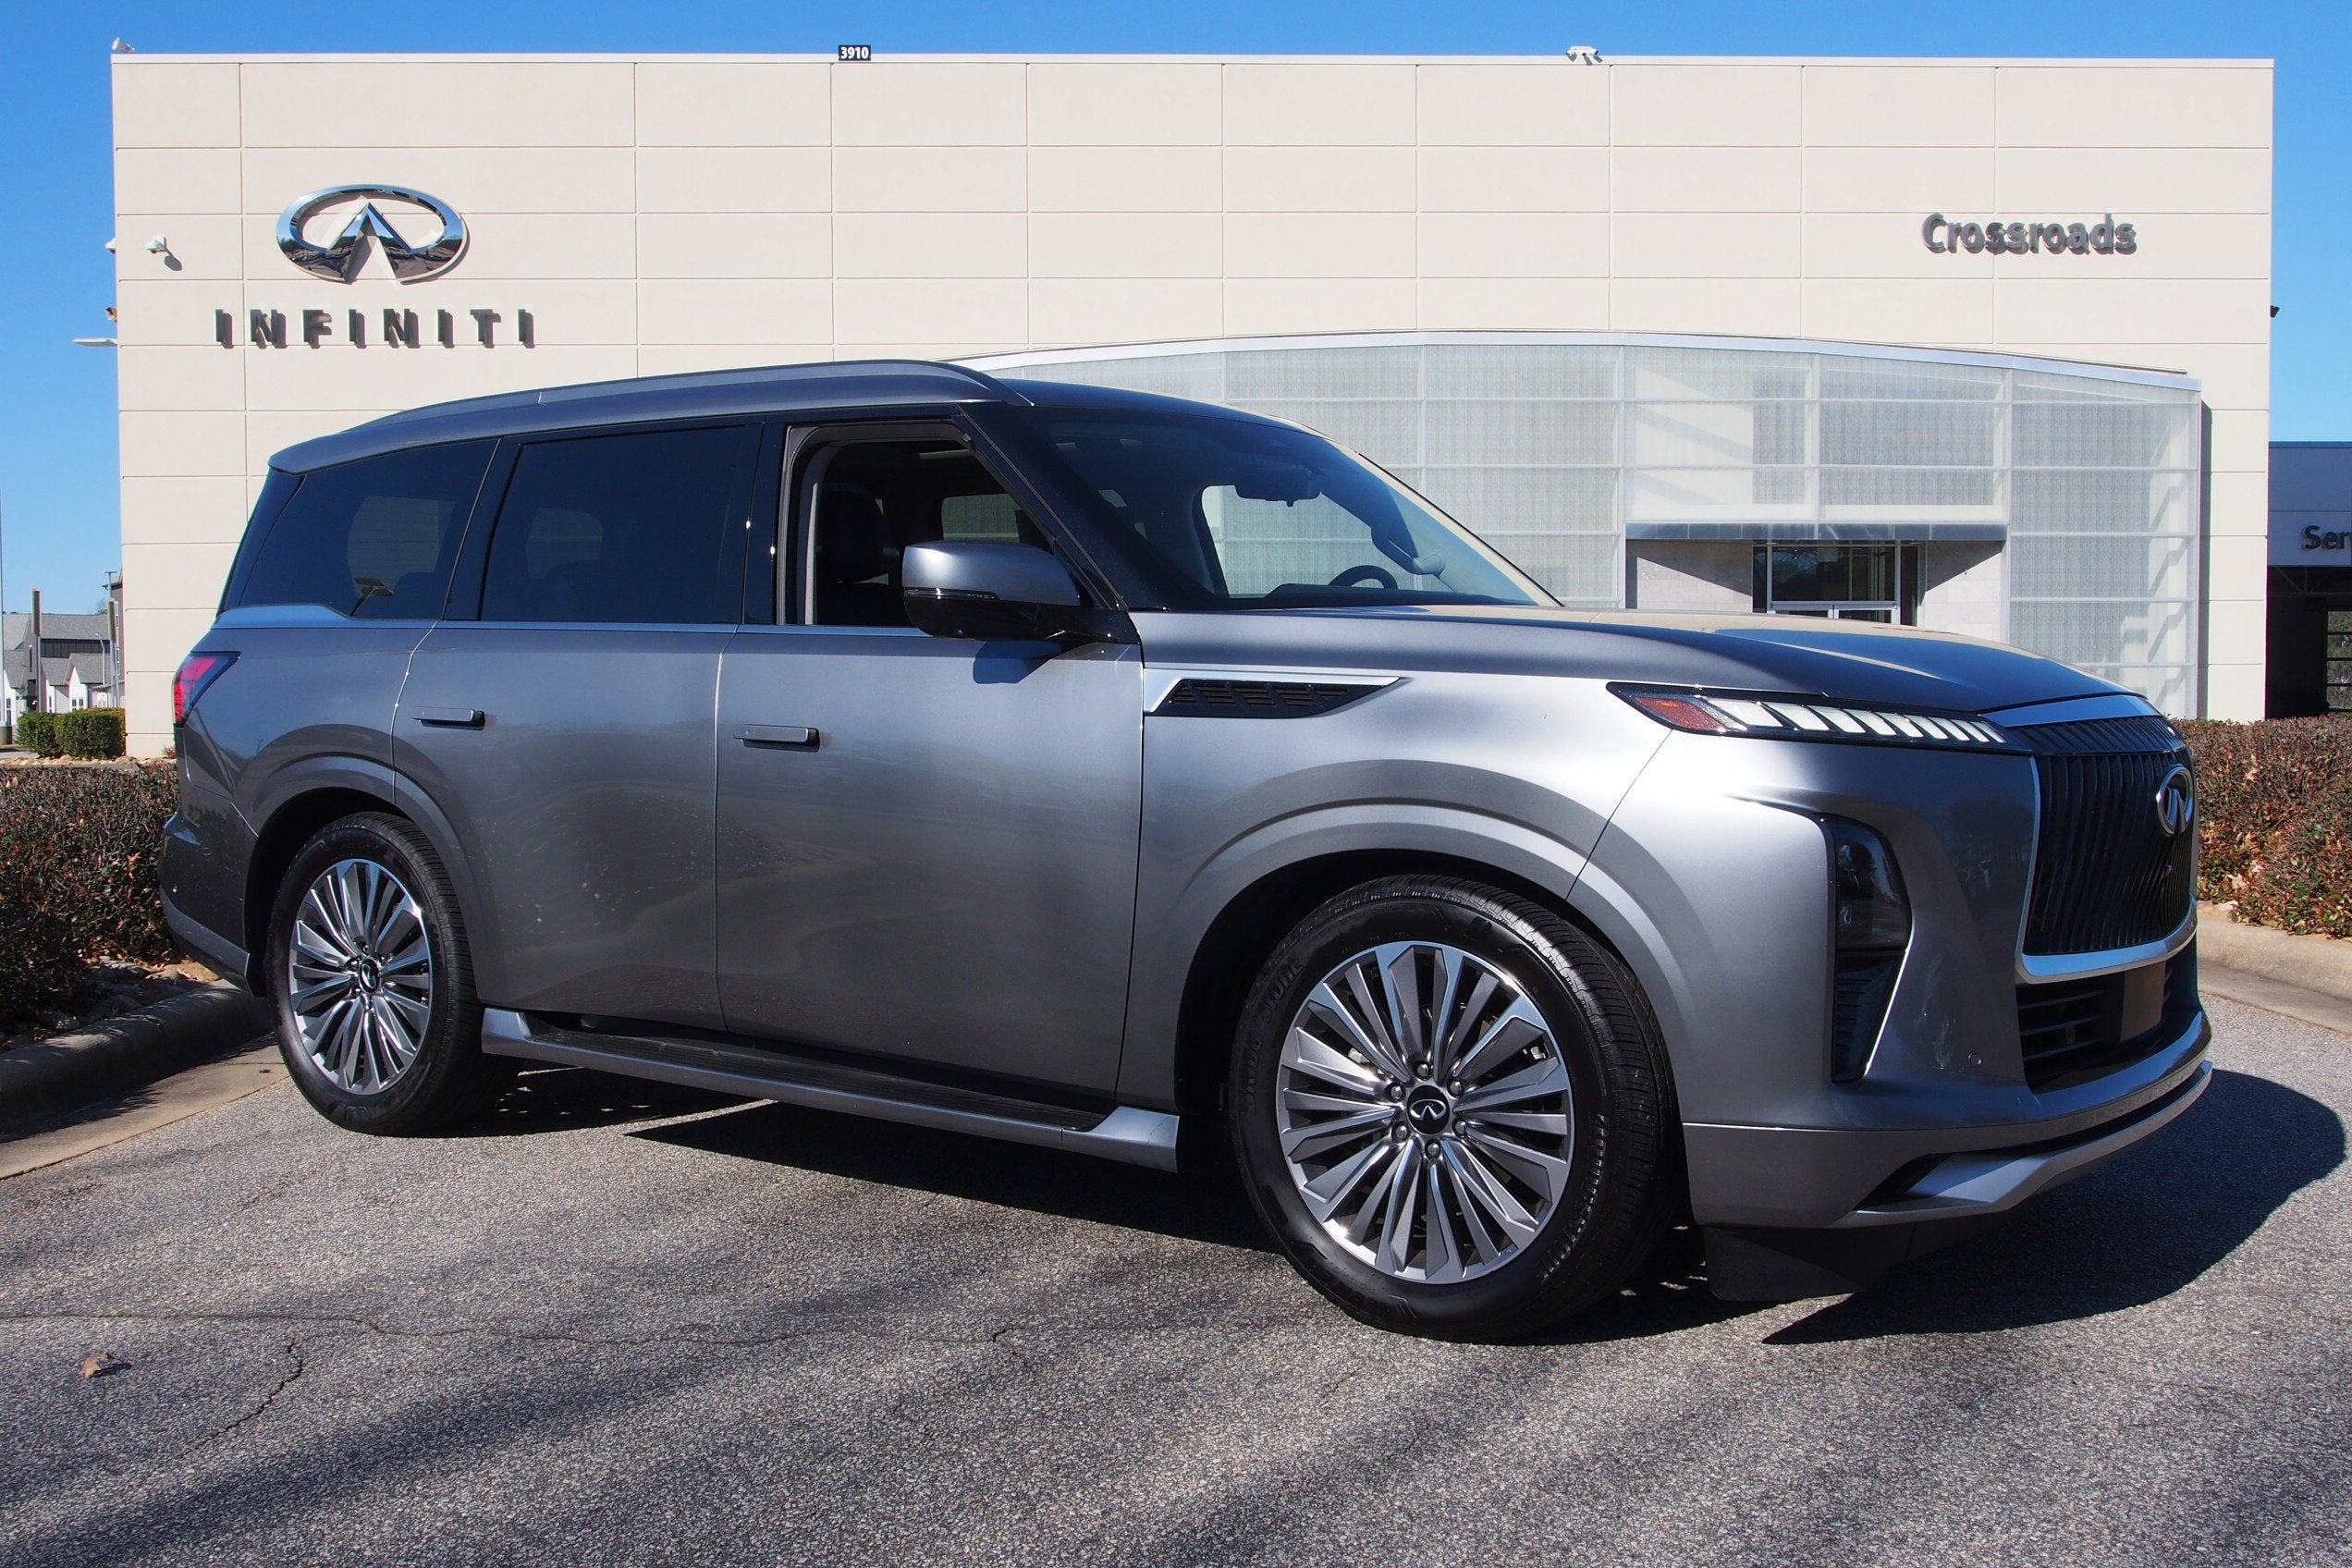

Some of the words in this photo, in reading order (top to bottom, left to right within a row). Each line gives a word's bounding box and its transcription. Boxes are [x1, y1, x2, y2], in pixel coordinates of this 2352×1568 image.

[839, 46, 869, 60] 3910
[1922, 213, 2137, 254] Crossroads
[215, 307, 533, 347] INFINITI
